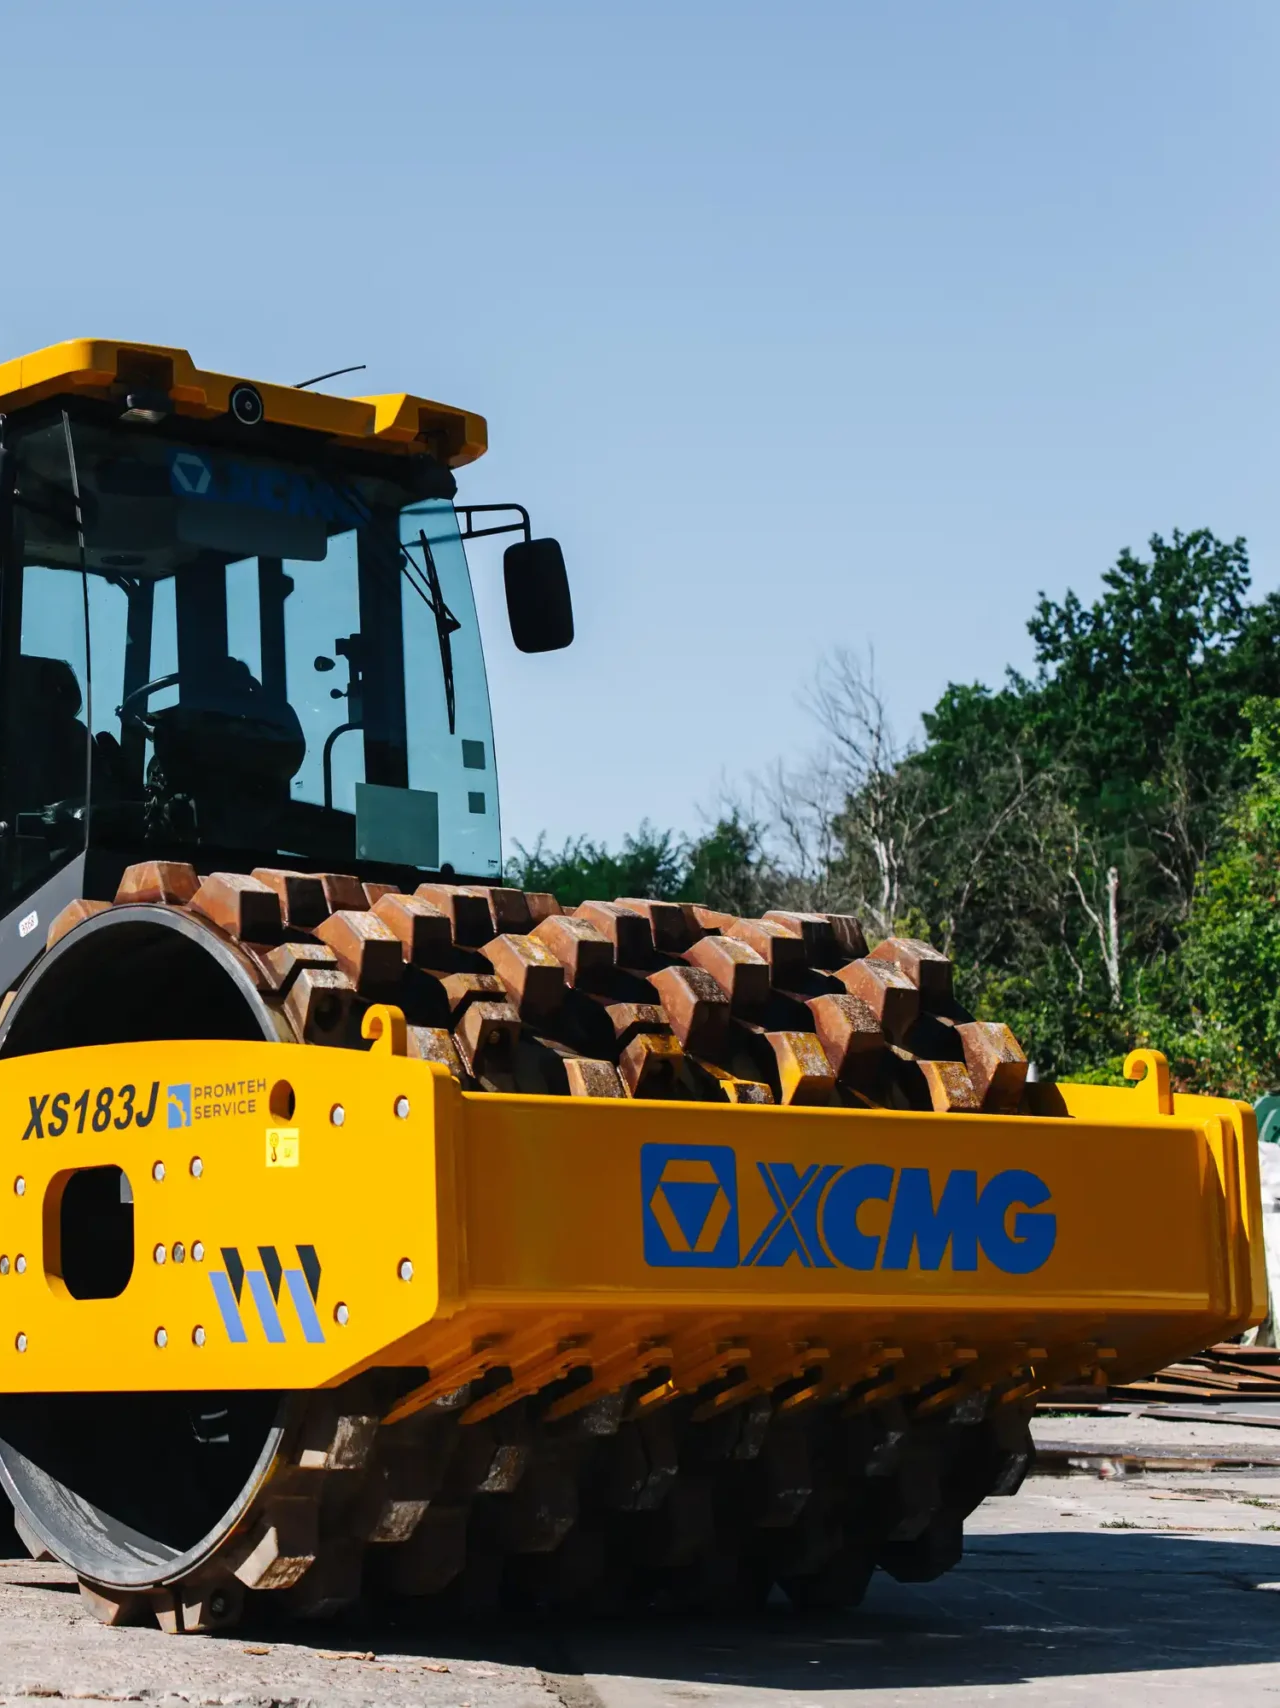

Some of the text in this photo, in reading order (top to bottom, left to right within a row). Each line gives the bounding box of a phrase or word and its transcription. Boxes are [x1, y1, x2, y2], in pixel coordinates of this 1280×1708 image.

[194, 1078, 267, 1099] PROMTEH
[22, 1081, 160, 1141] XS183J
[194, 1099, 257, 1120] SERVICE
[740, 1161, 1058, 1275] XCMG
